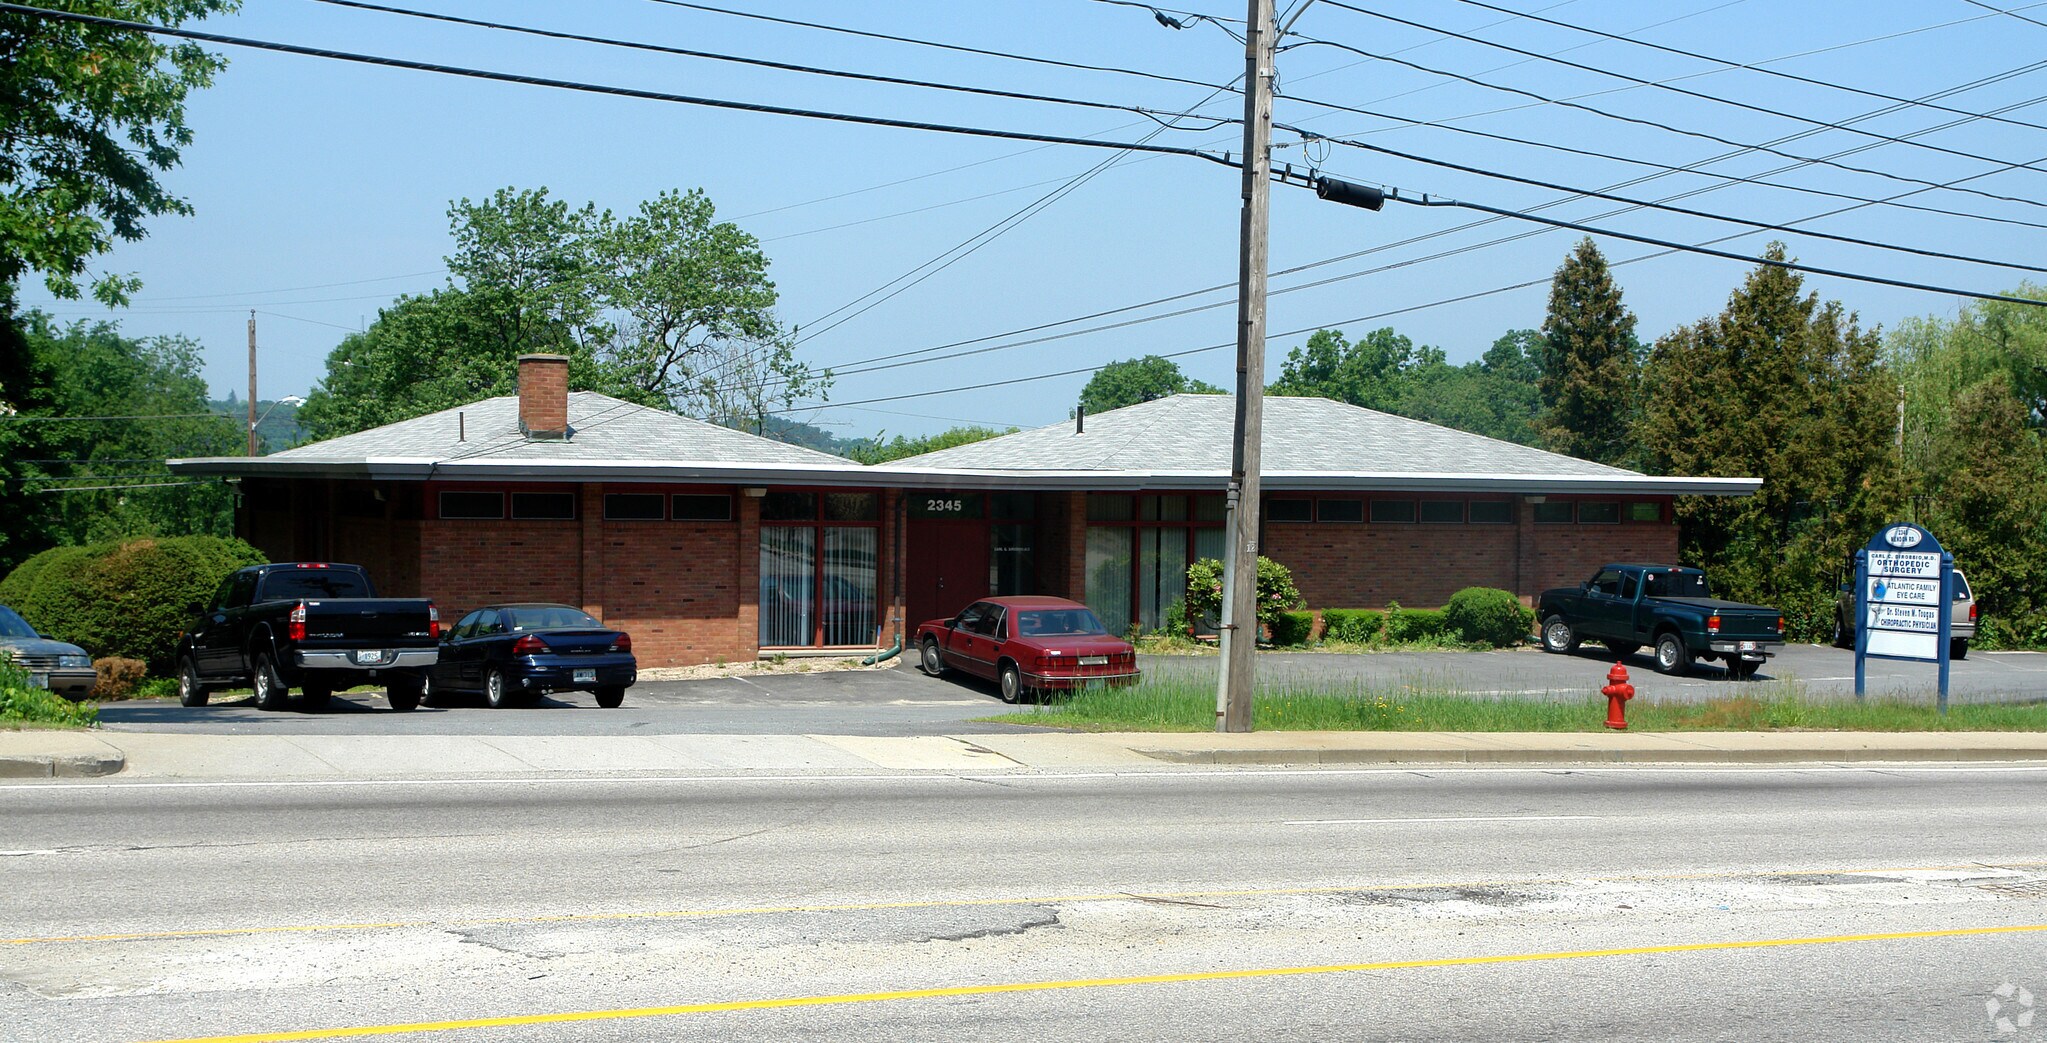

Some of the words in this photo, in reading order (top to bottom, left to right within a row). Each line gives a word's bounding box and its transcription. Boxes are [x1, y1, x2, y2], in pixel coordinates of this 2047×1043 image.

[927, 499, 962, 511] 2345
[1877, 559, 1930, 568] ORTHOPEDIC
[1887, 582, 1915, 591] ATLANTIC
[1916, 583, 1937, 592] FAMILY
[1896, 591, 1908, 599] EYE
[1909, 592, 1925, 600] CARE
[1894, 608, 1910, 617] Steven
[1918, 609, 1935, 620] Tougas
[1880, 618, 1911, 628] CHIROPRACTIC
[1912, 620, 1937, 629] PHYSICIAN
